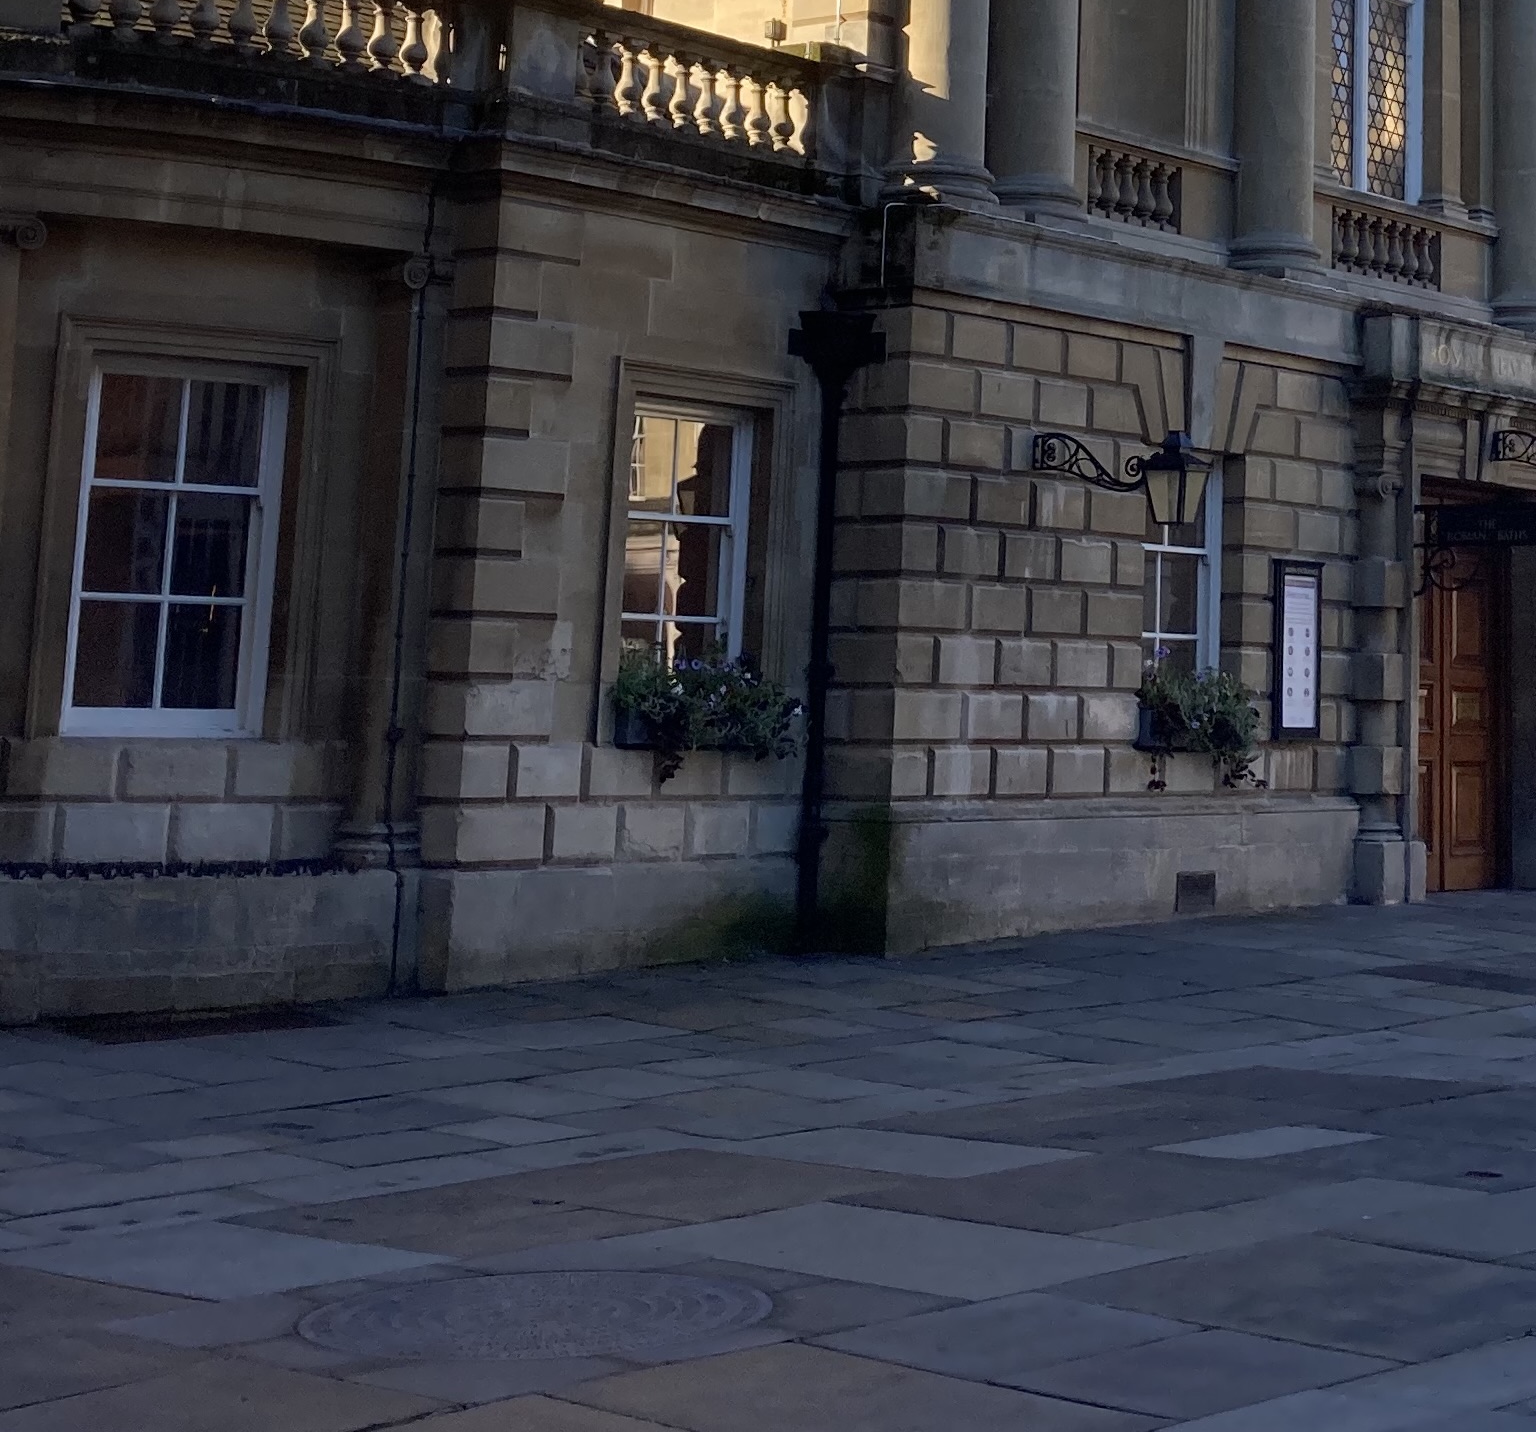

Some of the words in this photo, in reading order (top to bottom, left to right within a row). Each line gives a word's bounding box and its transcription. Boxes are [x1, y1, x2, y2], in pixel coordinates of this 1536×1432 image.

[1478, 518, 1498, 530] THE
[1446, 530, 1488, 542] ROMAN
[1497, 528, 1529, 542] BATHS
